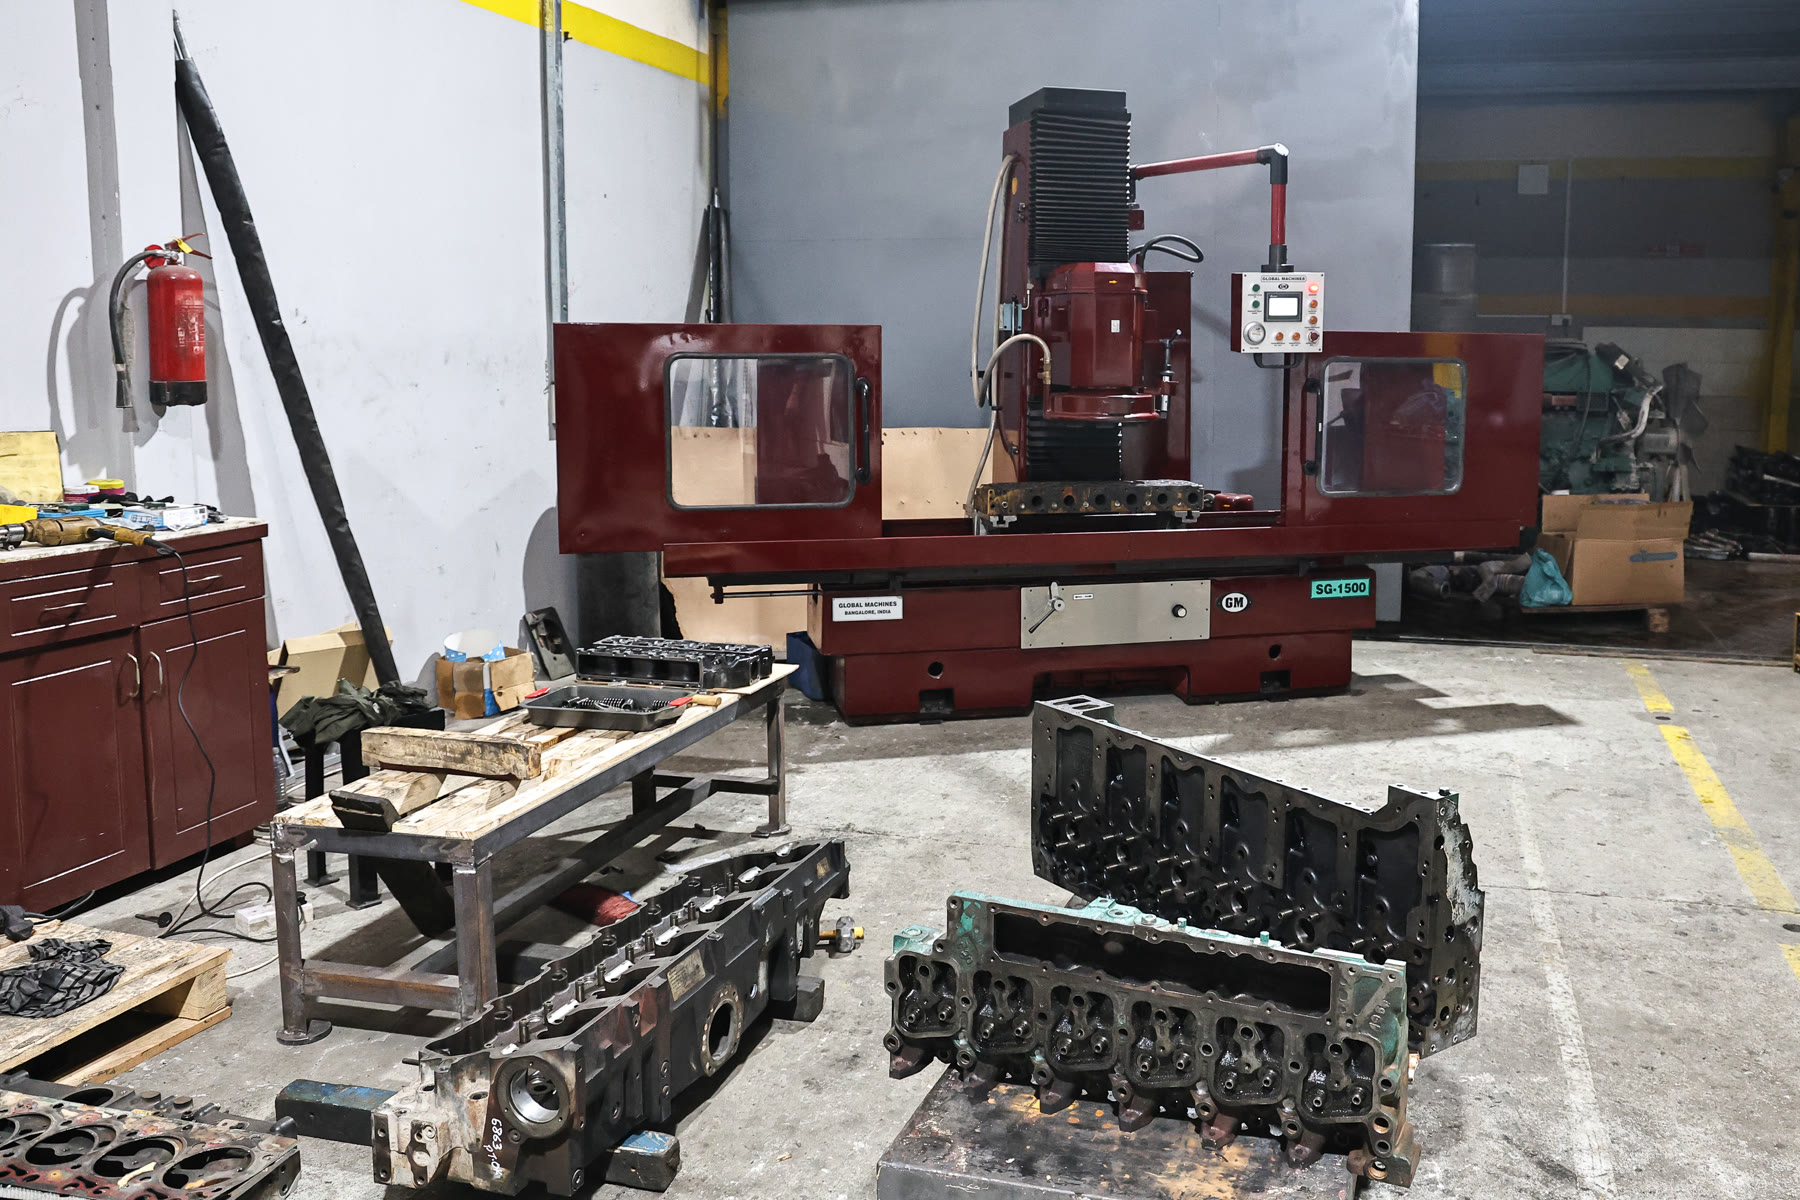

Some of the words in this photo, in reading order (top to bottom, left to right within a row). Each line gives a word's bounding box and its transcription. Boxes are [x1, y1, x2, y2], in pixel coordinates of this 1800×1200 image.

[1315, 582, 1366, 595] SG-1500
[1225, 597, 1244, 609] GM
[491, 1117, 503, 1151] 6863
